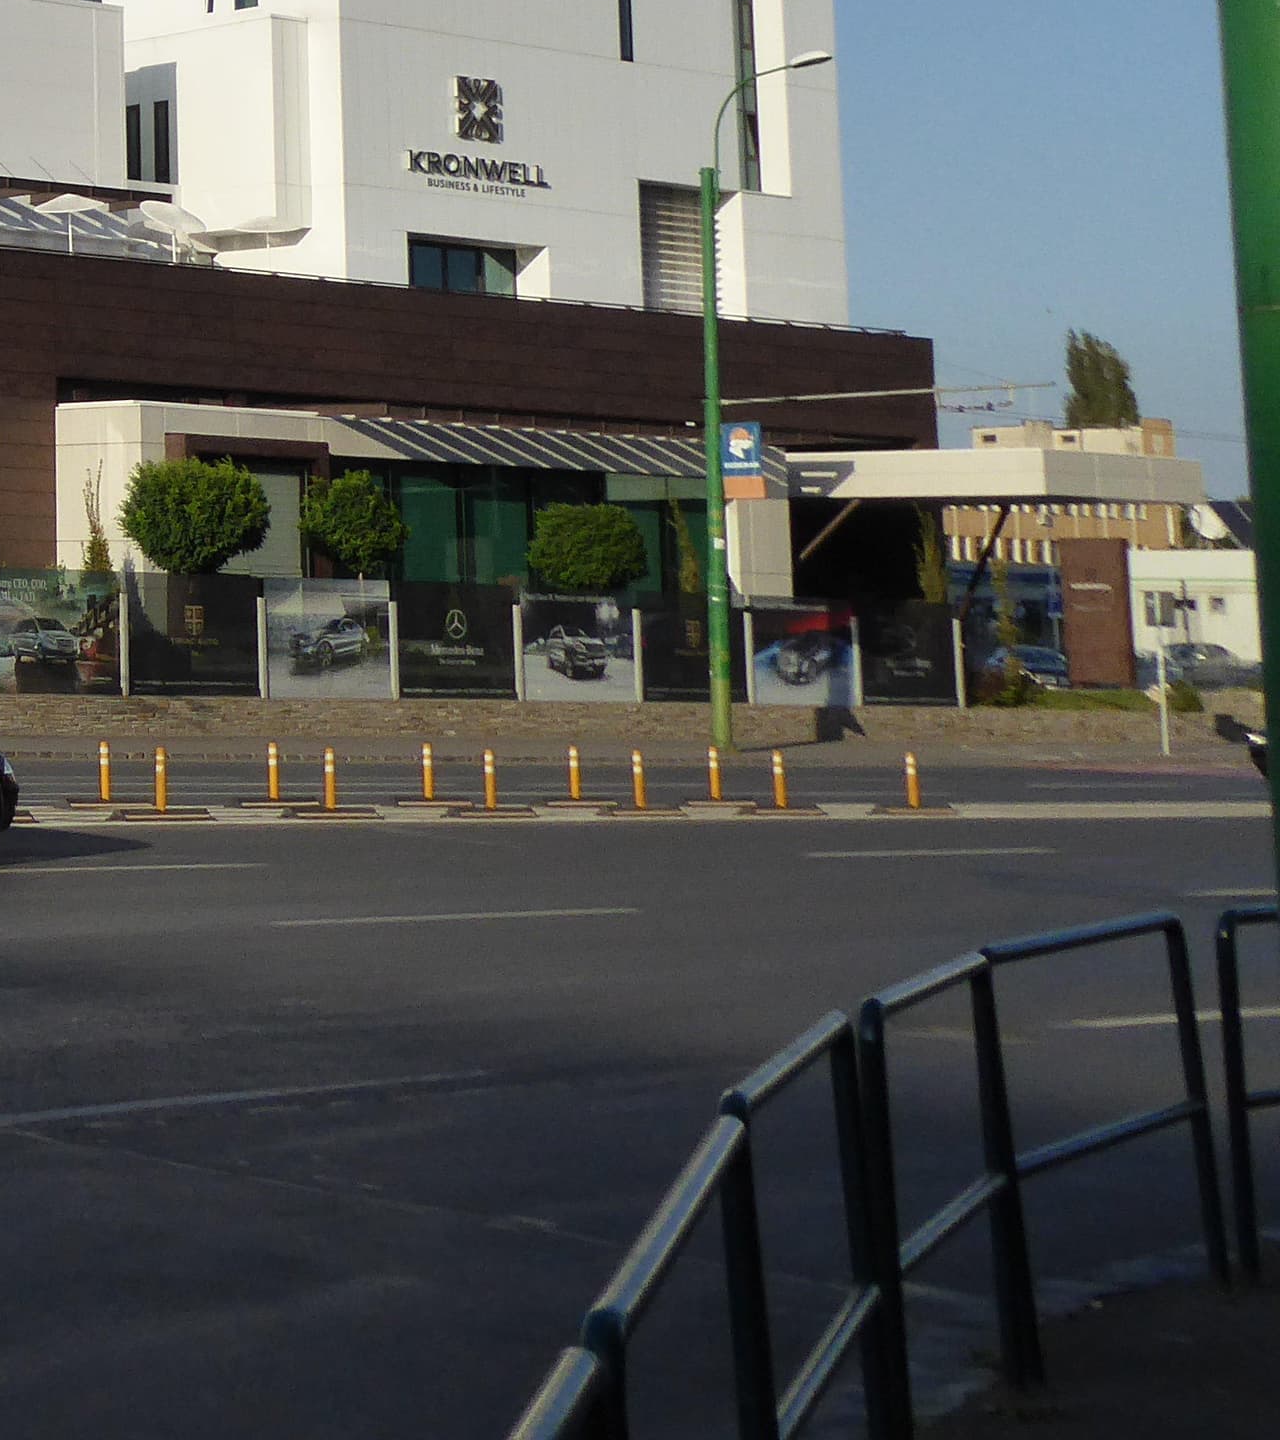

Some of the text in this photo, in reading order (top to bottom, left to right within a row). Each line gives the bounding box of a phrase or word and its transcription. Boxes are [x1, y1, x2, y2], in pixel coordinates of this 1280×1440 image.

[406, 149, 552, 189] KRONWELL
[427, 177, 526, 198] BUSINESS & LIFESTYLE
